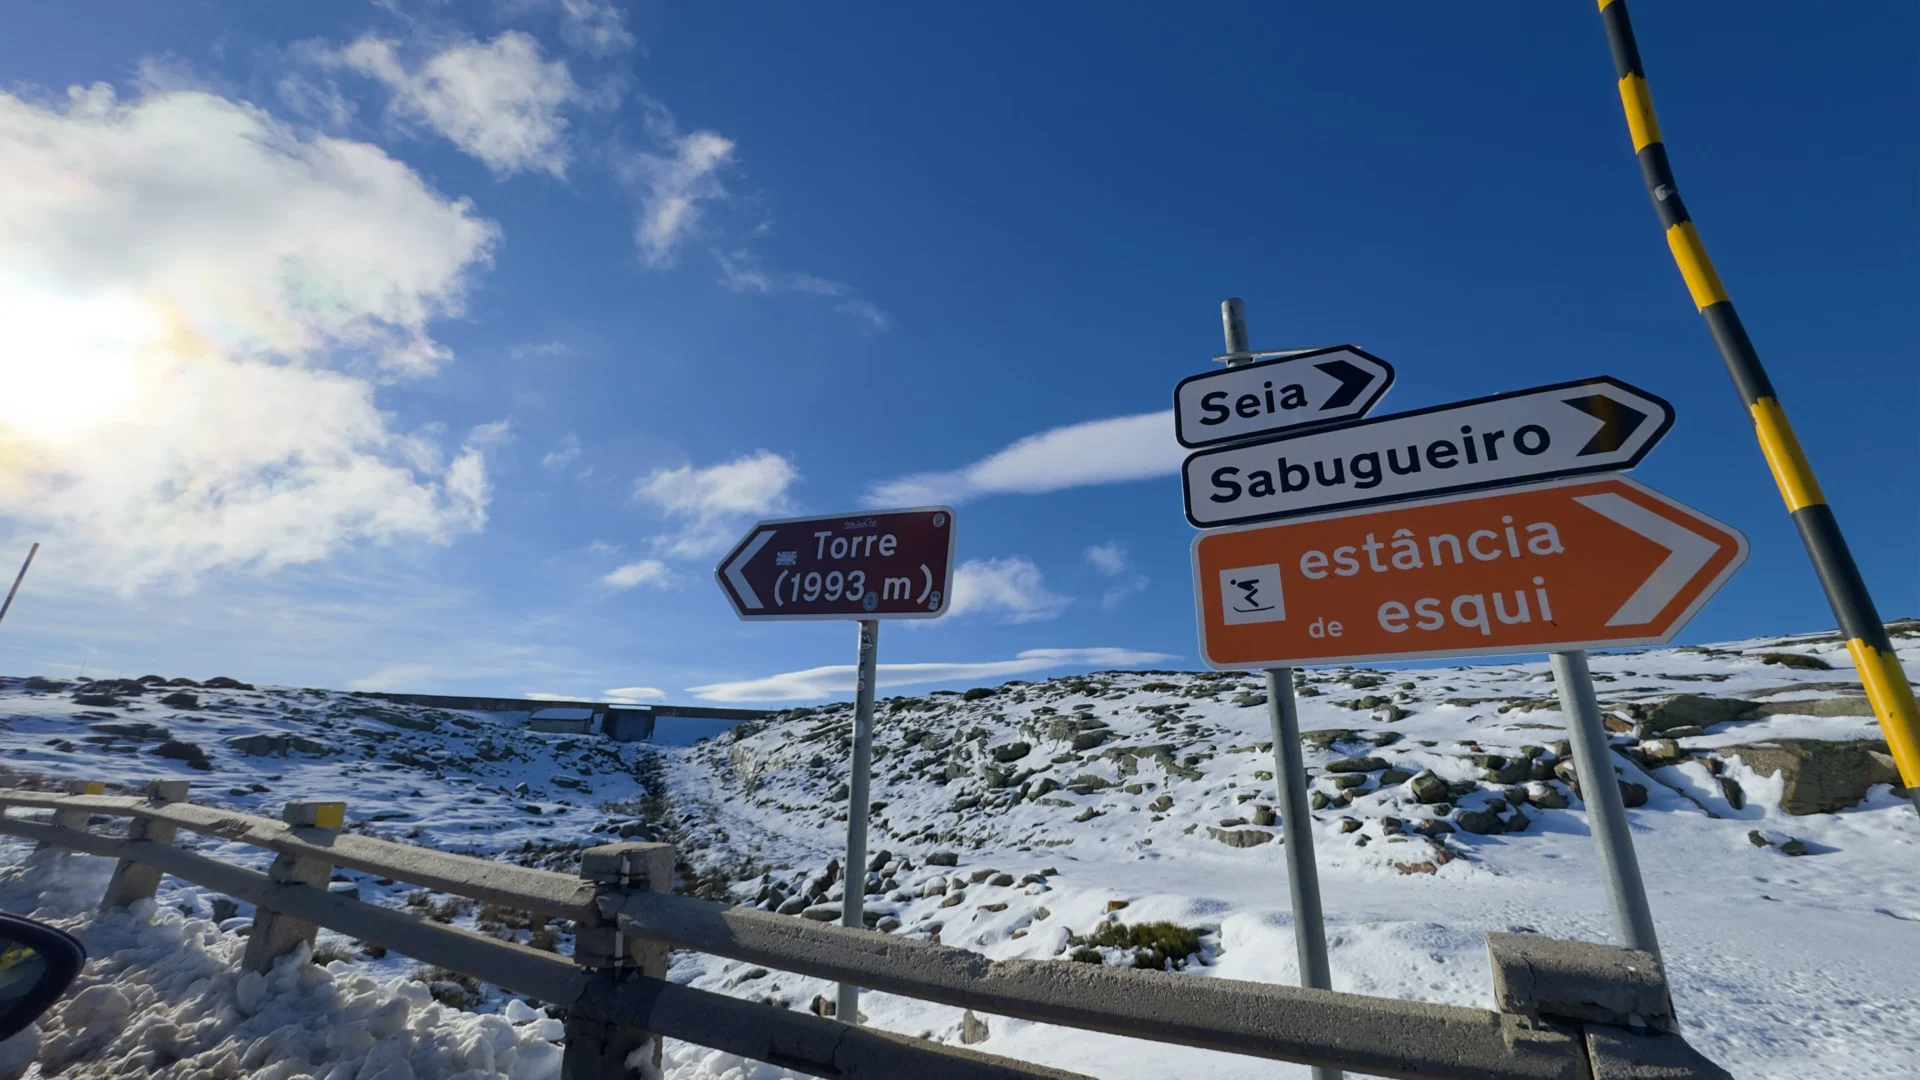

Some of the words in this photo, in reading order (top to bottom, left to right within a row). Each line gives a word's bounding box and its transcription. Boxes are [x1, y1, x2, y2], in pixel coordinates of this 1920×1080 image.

[1198, 380, 1309, 427] Seia
[1208, 424, 1552, 504] Sabugueiro
[814, 530, 898, 560] Torre
[1299, 514, 1564, 580] estância
[773, 568, 866, 607] (1993
[1308, 615, 1344, 639] de
[1377, 576, 1553, 636] esqui
